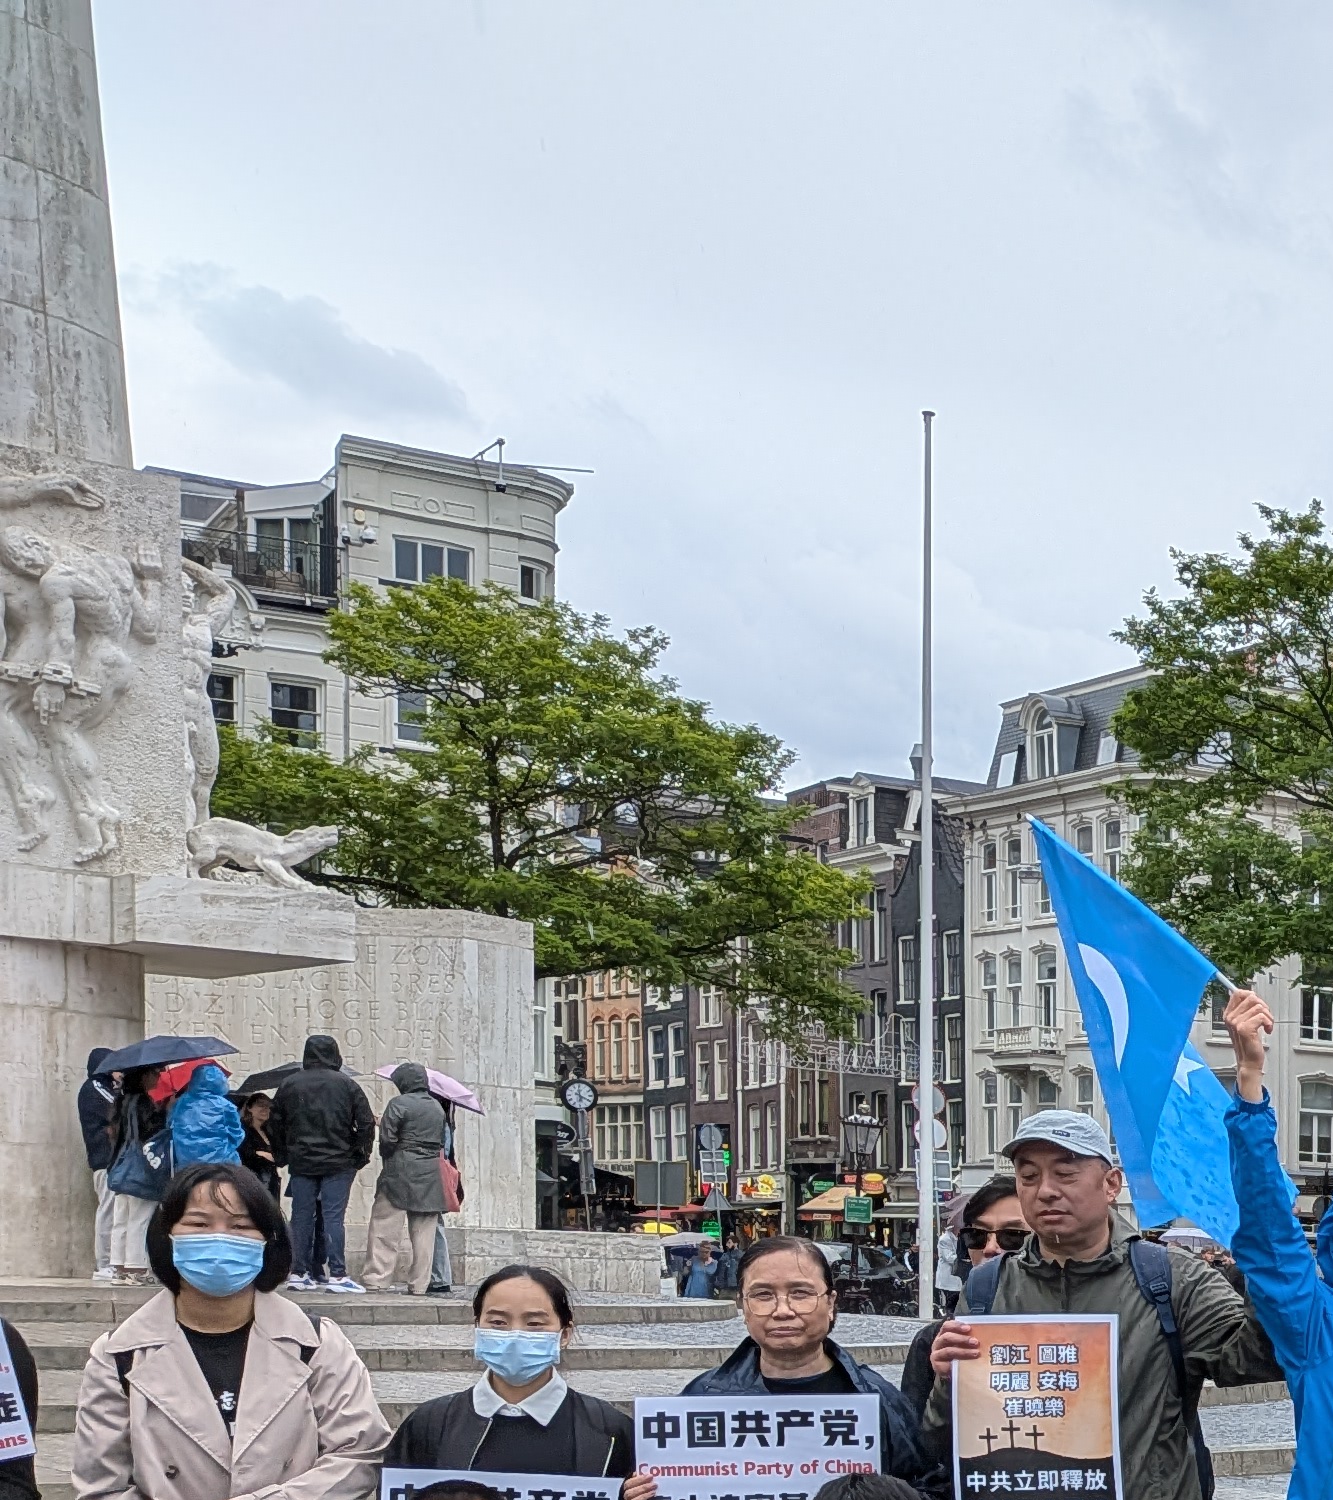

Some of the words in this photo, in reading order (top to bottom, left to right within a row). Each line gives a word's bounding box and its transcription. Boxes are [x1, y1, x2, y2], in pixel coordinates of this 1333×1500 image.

[991, 1344, 1030, 1365] 劉江
[991, 1371, 1030, 1391] 明麗
[1038, 1370, 1079, 1390] 安梅
[638, 1461, 739, 1477] Communist
[744, 1461, 794, 1479] Party
[799, 1459, 820, 1475] of
[966, 1468, 1109, 1492] 中共立即釋放
